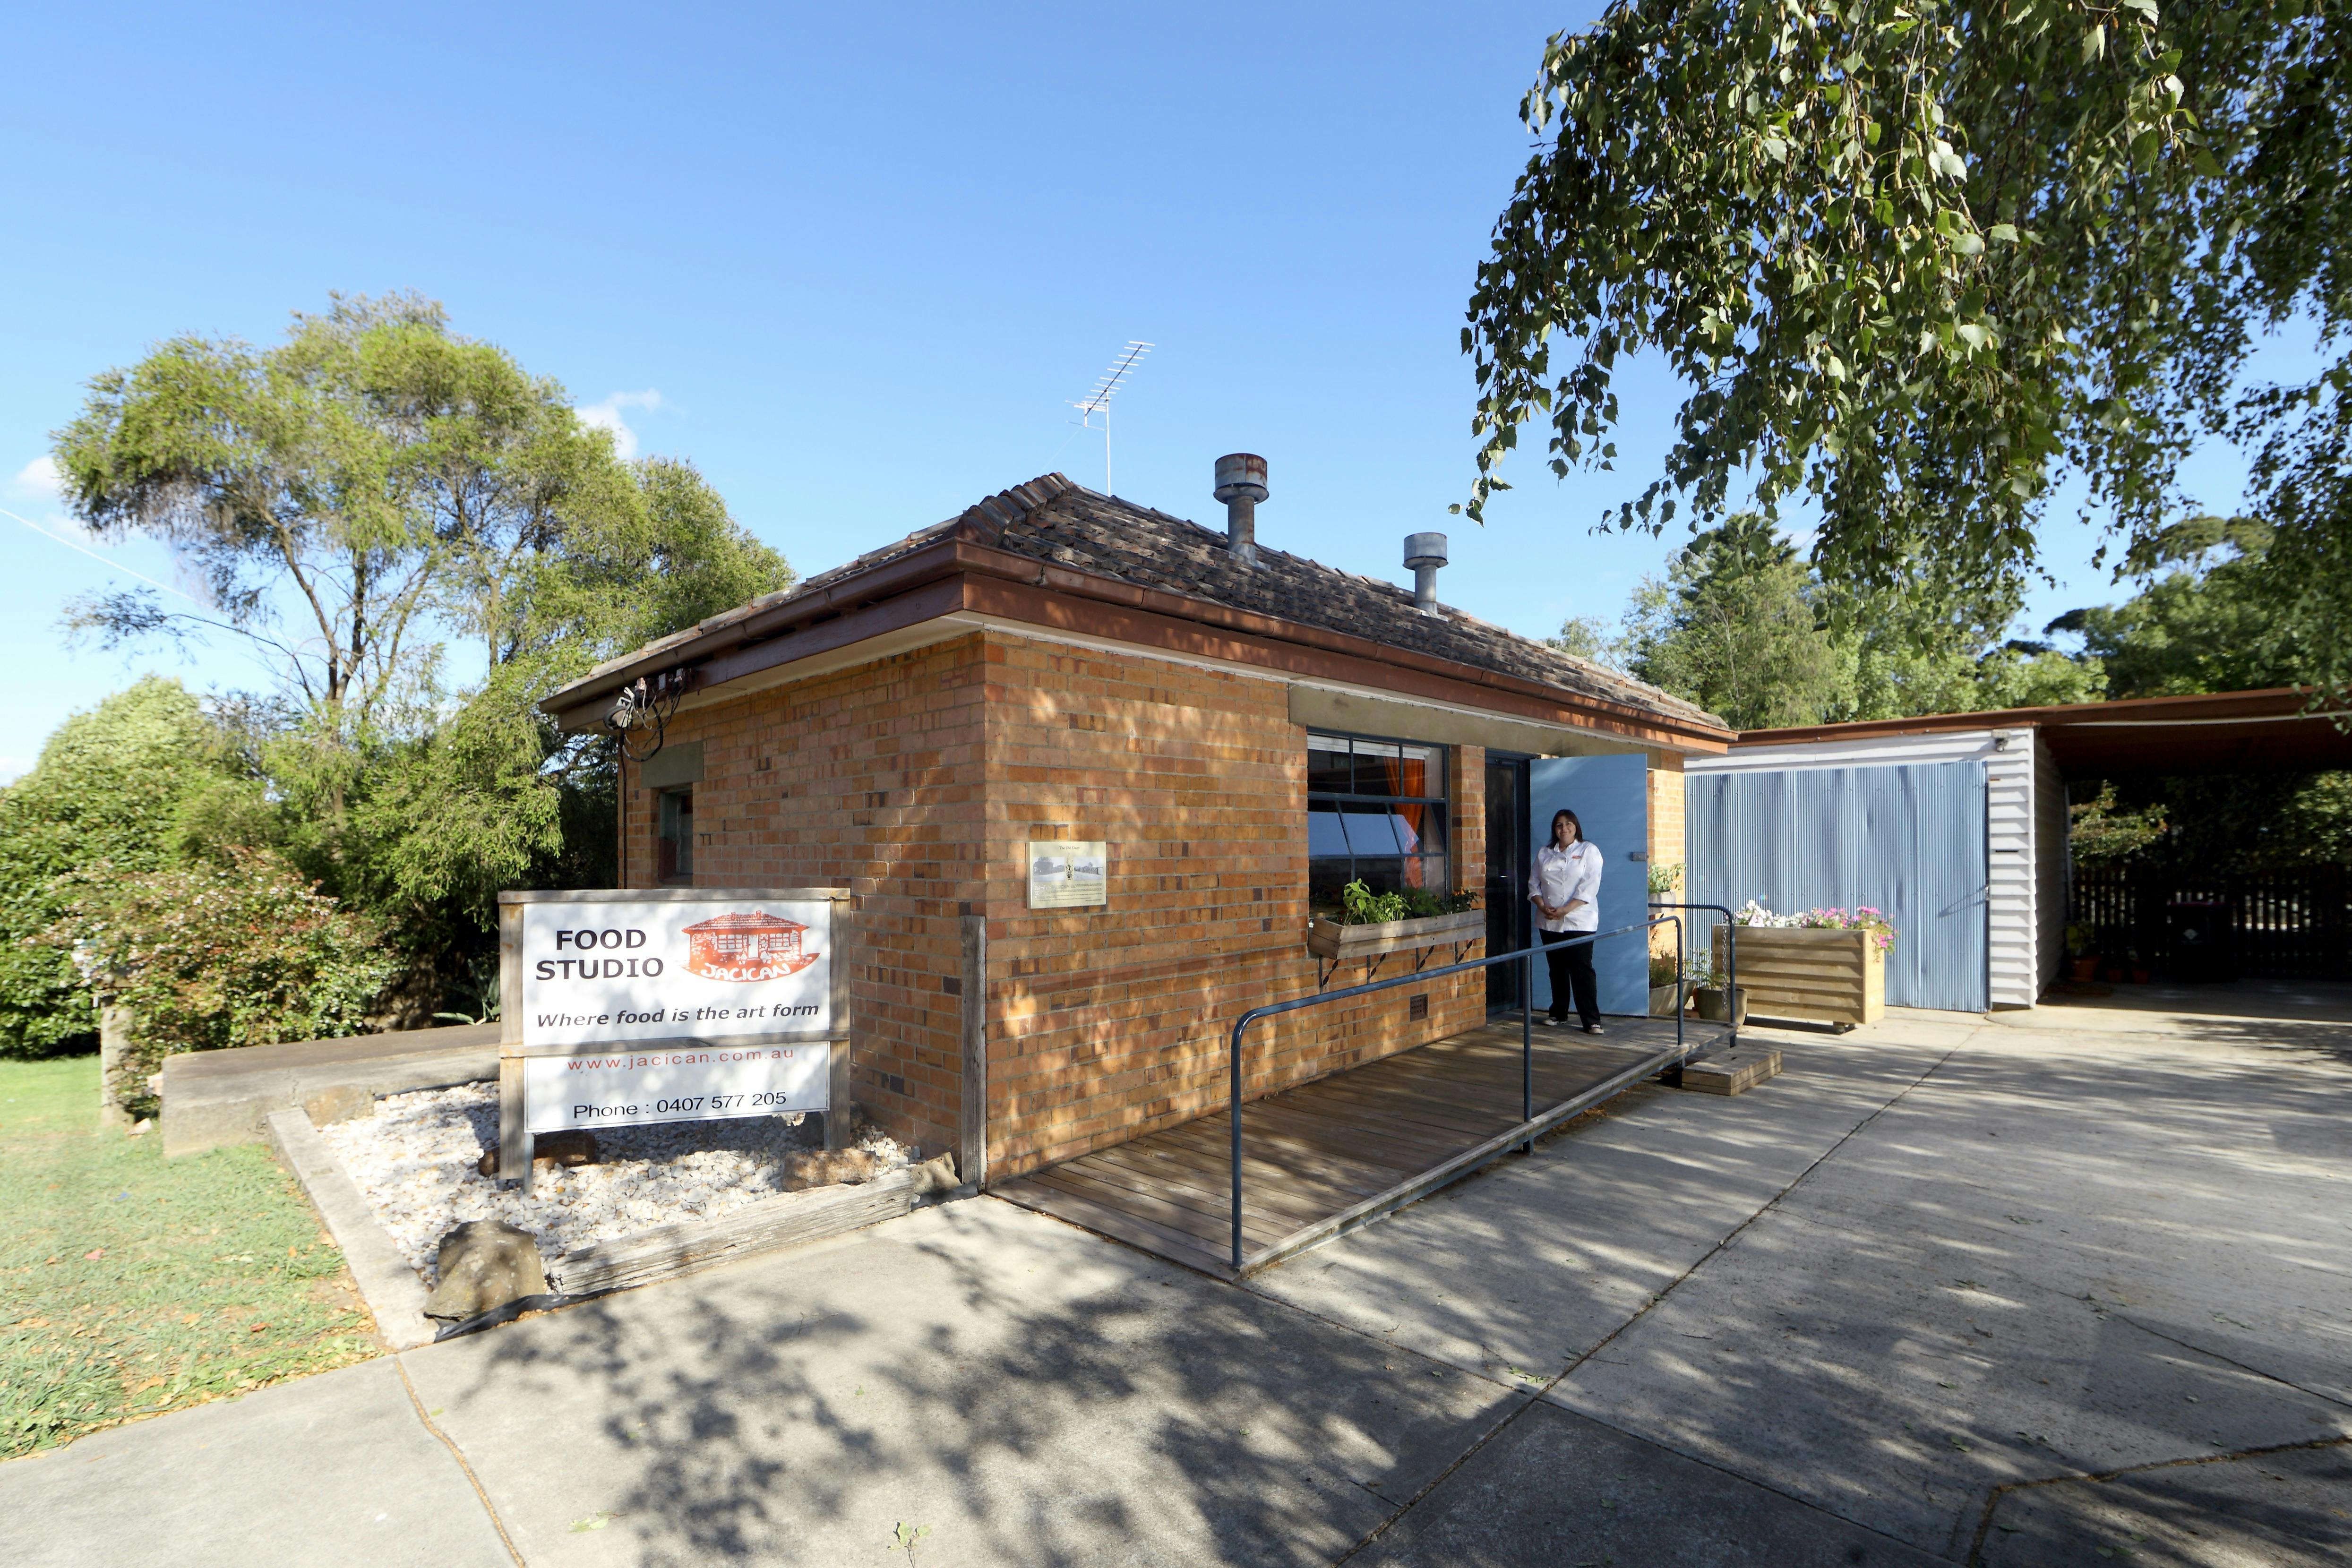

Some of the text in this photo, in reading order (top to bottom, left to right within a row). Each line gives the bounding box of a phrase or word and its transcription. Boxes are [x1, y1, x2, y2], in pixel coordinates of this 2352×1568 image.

[556, 929, 646, 950] FOOD
[536, 958, 663, 980] STUDIO
[700, 962, 791, 981] JACICAN
[538, 1003, 819, 1027] Where food is the art form
[567, 1049, 794, 1070] www.jacican.com.au
[574, 1105, 638, 1119] Phone
[657, 1097, 704, 1113] 0407
[711, 1095, 745, 1109] 577
[752, 1092, 787, 1106] 205
